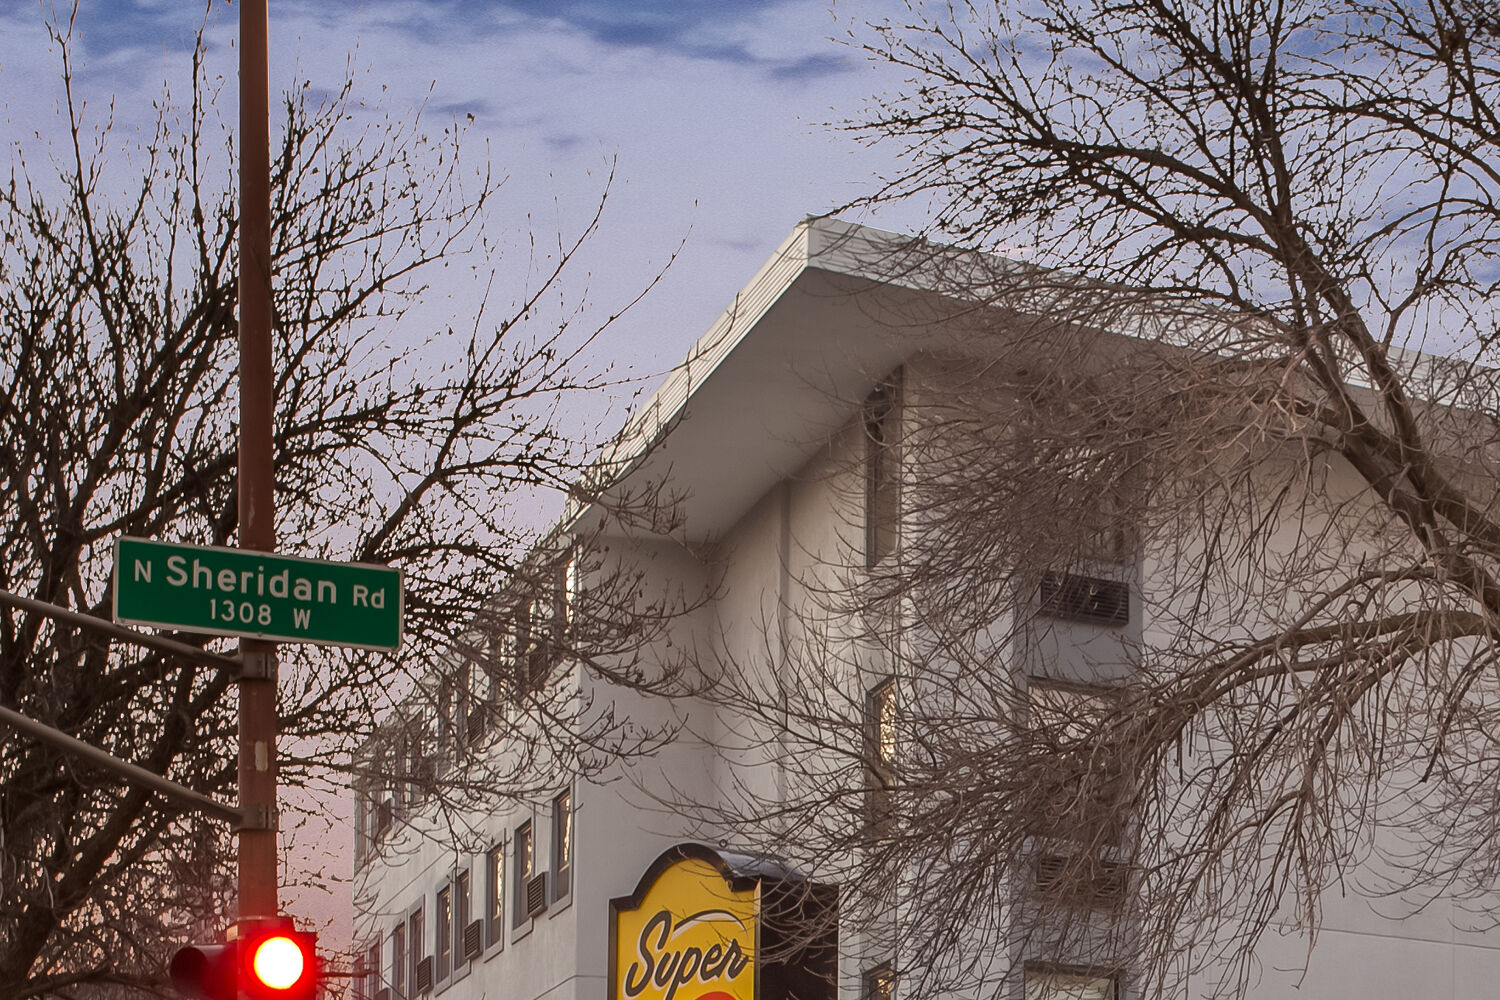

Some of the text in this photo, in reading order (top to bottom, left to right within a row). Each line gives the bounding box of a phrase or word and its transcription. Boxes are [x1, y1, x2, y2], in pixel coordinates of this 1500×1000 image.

[134, 555, 385, 609] N Sheridan Rd
[210, 598, 311, 630] 1308 W
